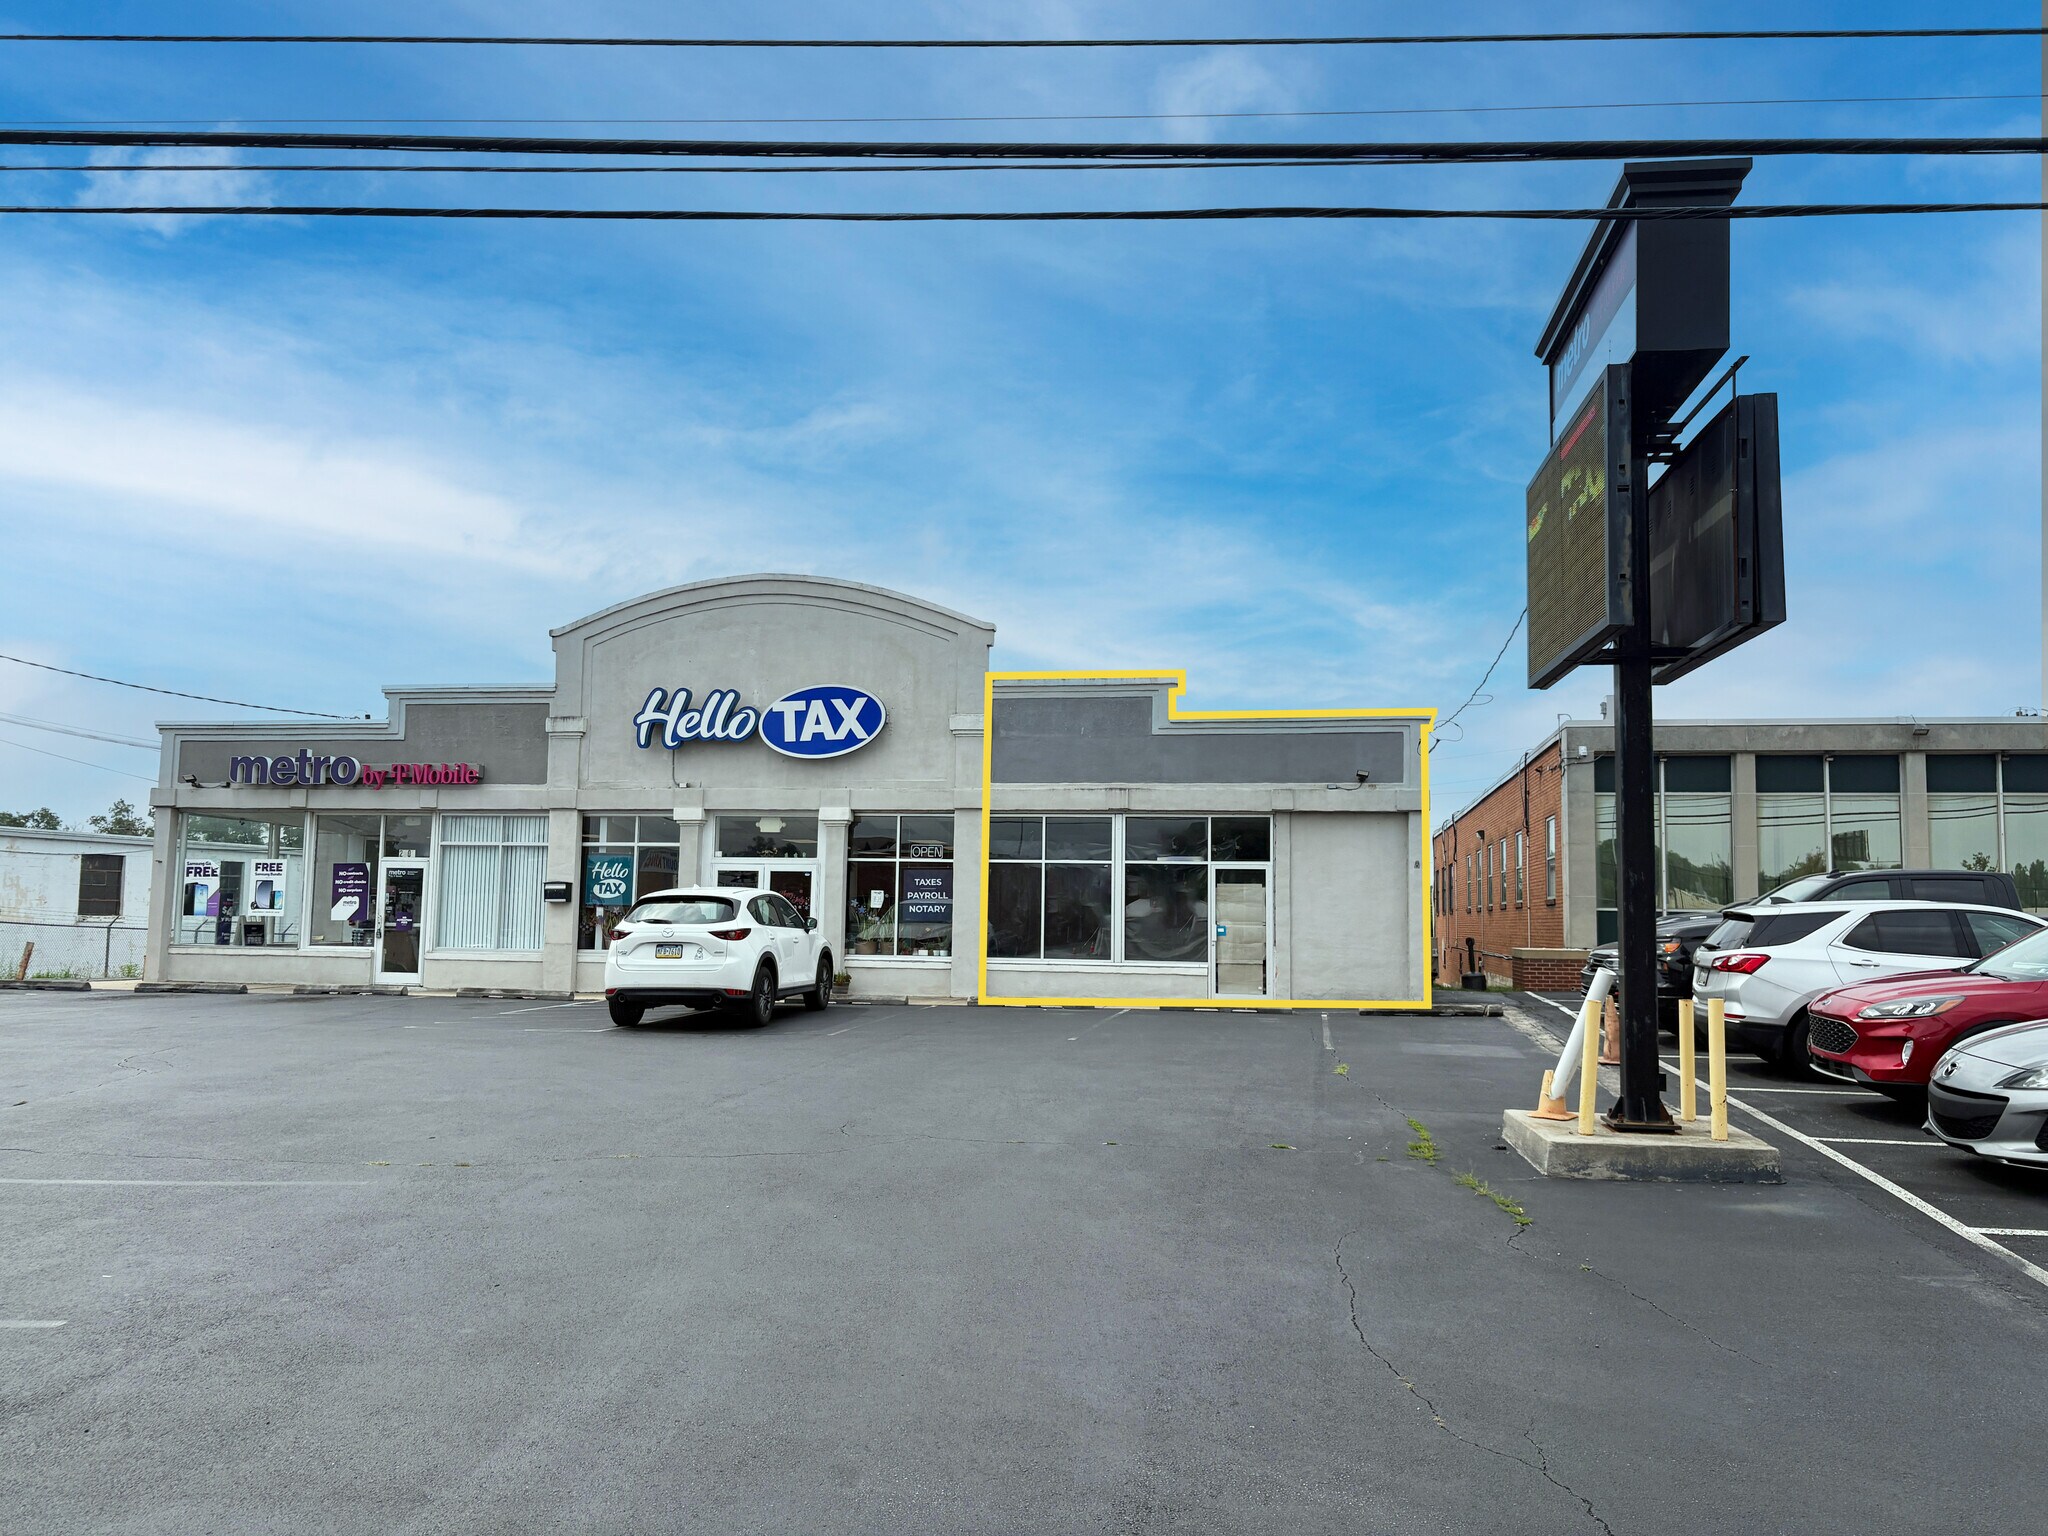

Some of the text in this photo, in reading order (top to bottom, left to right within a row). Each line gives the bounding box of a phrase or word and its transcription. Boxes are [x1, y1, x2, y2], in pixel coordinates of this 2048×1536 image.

[1557, 313, 1591, 393] metro
[634, 688, 870, 749] Hello TAX
[229, 748, 361, 786] metro
[362, 764, 388, 790] by
[912, 846, 942, 858] OPEN
[186, 866, 218, 877] FREE
[255, 863, 283, 871] FREE
[592, 861, 629, 880] Hello
[596, 883, 622, 894] TAX
[907, 891, 949, 900] PAYROLL
